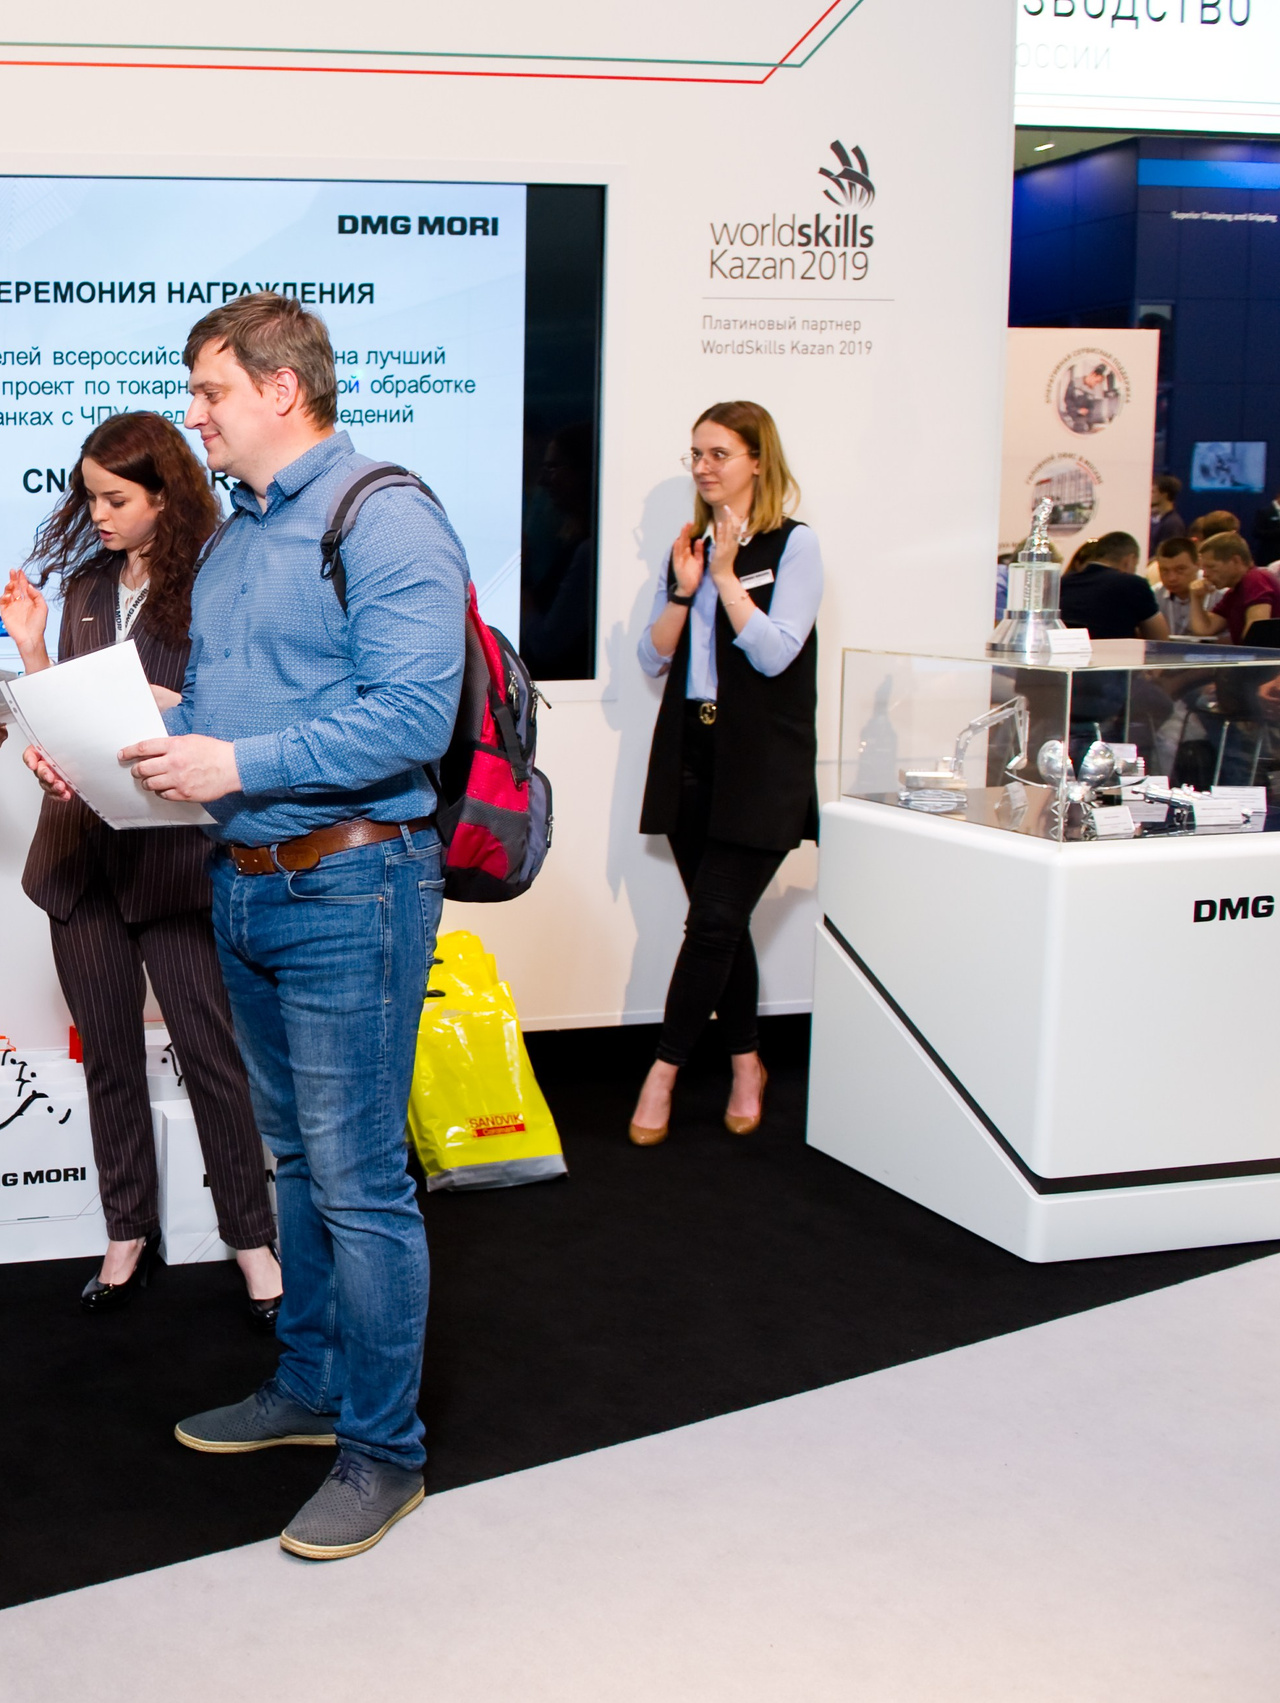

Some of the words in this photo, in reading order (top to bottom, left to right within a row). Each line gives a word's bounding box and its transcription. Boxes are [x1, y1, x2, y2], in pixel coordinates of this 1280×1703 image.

[337, 214, 412, 235] DMG
[418, 216, 499, 236] MORI
[710, 249, 795, 280] Kazan
[800, 250, 869, 281] 2019
[702, 315, 797, 330] Платиновый
[801, 318, 862, 334] партнер
[334, 350, 359, 365] на
[365, 346, 446, 370] лучший
[701, 340, 786, 355] WorldSkills
[790, 340, 835, 355] Kazan
[839, 341, 873, 355] 2019
[2, 380, 75, 400] проект
[85, 380, 110, 394] по
[370, 375, 476, 398] обработке
[22, 468, 71, 493] CN
[1193, 895, 1275, 923] DMG
[469, 1113, 523, 1128] SANDVIK
[23, 1166, 87, 1186] MORI
